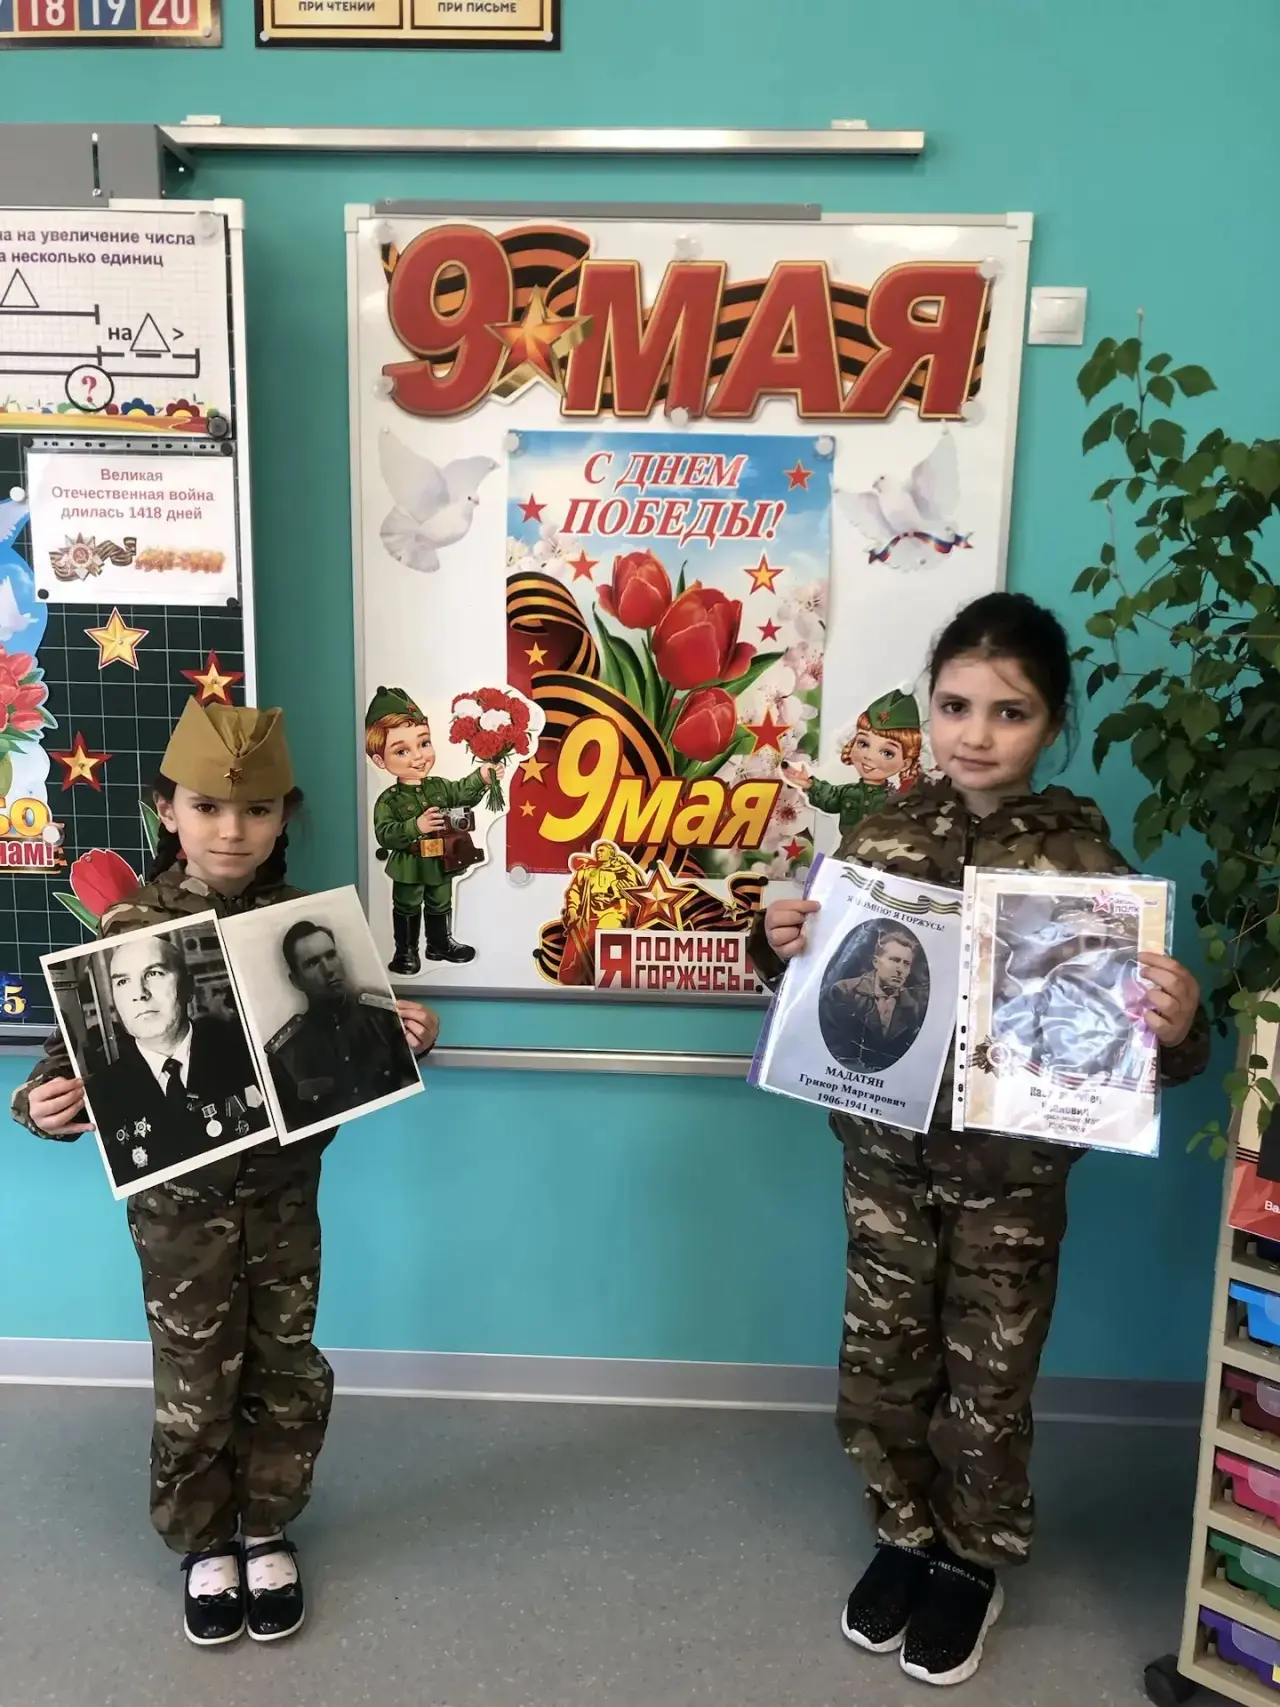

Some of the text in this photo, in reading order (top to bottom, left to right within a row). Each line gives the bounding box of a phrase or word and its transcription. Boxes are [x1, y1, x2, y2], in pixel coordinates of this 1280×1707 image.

[31, 0, 66, 26] 18
[92, 0, 125, 25] 19
[148, 0, 191, 25] 20
[298, 1, 376, 12] ПРИ ЧТЕНИИ
[438, 2, 517, 13] ПРИ ПИСЬМЕ
[17, 231, 36, 241] на
[41, 231, 140, 245] увеличение
[145, 233, 196, 246] числа
[11, 252, 96, 264] несколько
[101, 253, 164, 267] единиц
[108, 326, 133, 341] на
[382, 225, 991, 420] 9 МАЯ
[81, 375, 97, 404] ?
[100, 468, 164, 482] Великая
[583, 452, 748, 494] С ДНЕМ
[51, 486, 215, 502] Отечественная война
[61, 506, 203, 522] длилась 1418 дней
[560, 497, 787, 549] ПОБЕДЫ!
[537, 715, 621, 844] 9
[893, 911, 900, 920] Я
[901, 914, 945, 932] ГОРЖУСЬ!
[598, 933, 740, 989] Я ПОМНЮ
[825, 1066, 885, 1089] МАДАТЯН
[799, 1073, 906, 1108] Грикор Маргарович
[817, 1092, 867, 1112] 1906-1941
